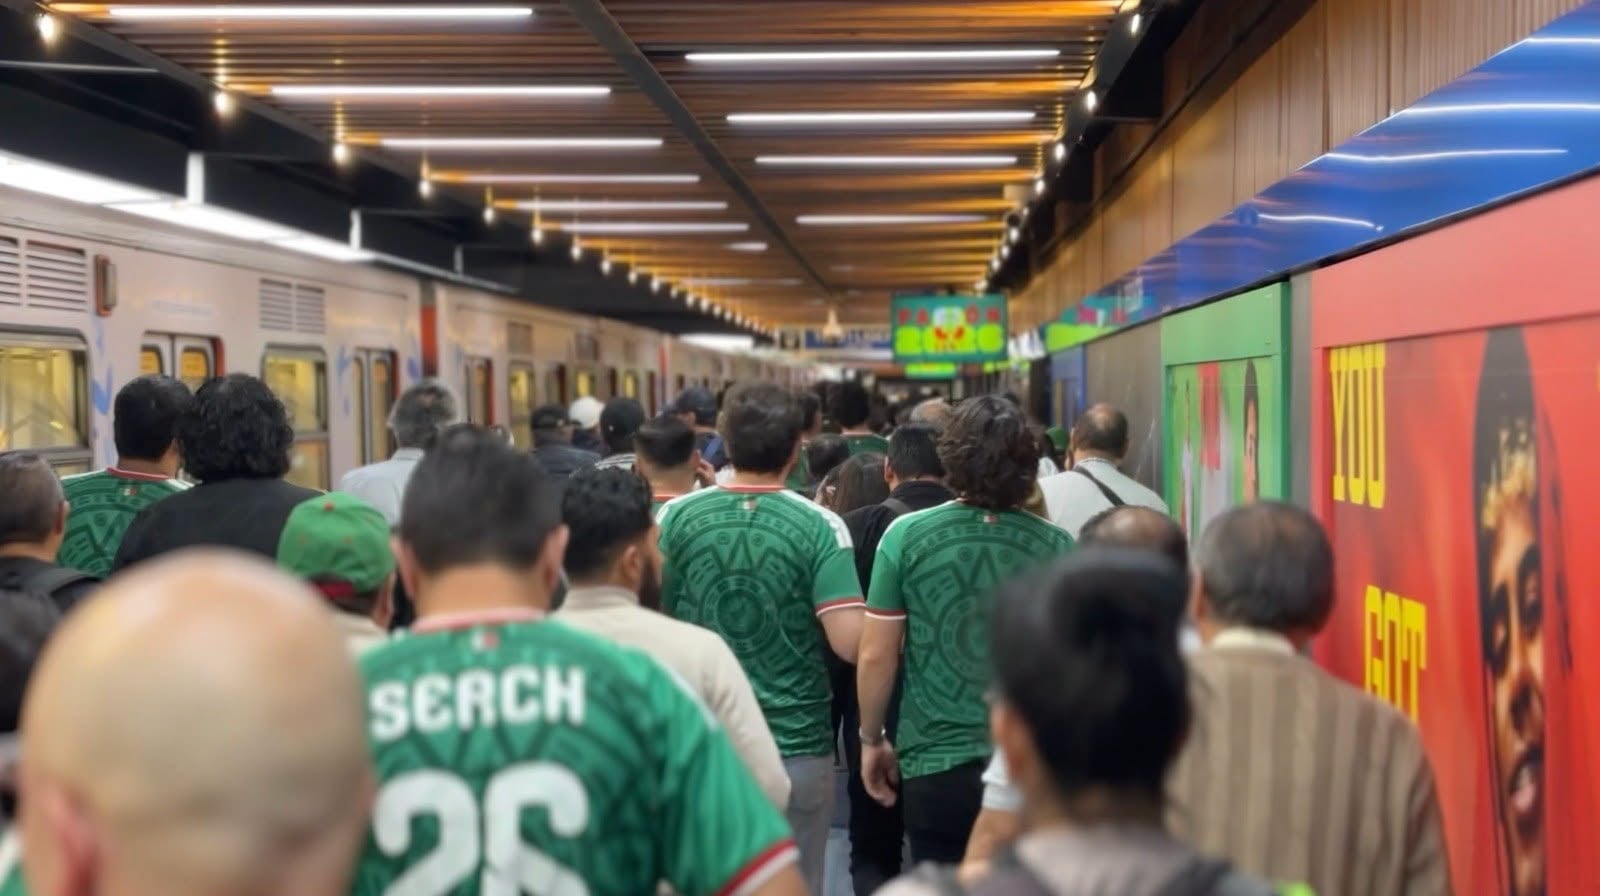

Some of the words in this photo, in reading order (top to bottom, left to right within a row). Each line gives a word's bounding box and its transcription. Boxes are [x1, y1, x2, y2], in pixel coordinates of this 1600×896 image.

[1330, 343, 1385, 509] YOU
[370, 664, 585, 742] SERCH
[1365, 585, 1426, 725] GOT
[373, 760, 589, 896] 26
